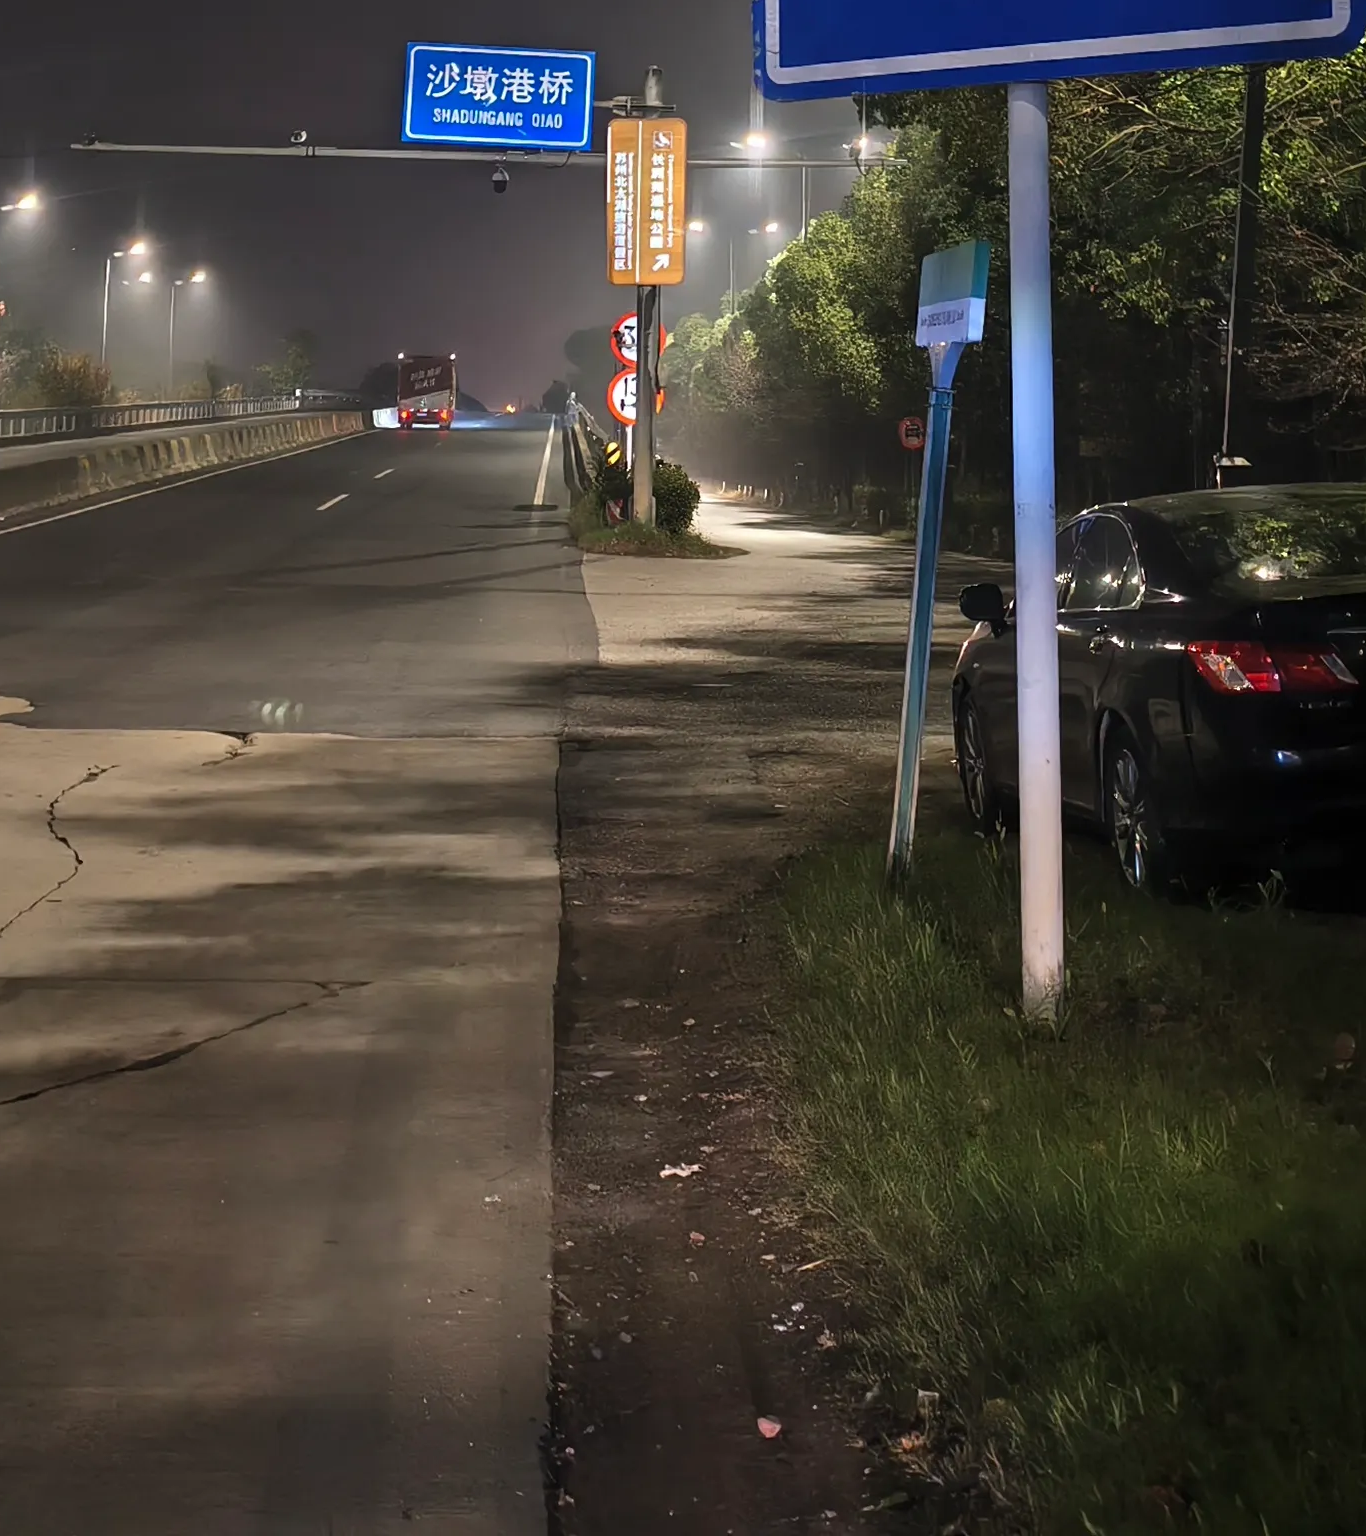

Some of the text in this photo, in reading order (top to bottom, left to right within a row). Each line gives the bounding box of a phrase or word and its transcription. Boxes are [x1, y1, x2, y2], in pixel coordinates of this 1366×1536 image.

[425, 61, 574, 106] 沙墩港桥
[432, 107, 563, 129] SHADUNGANG QIAO
